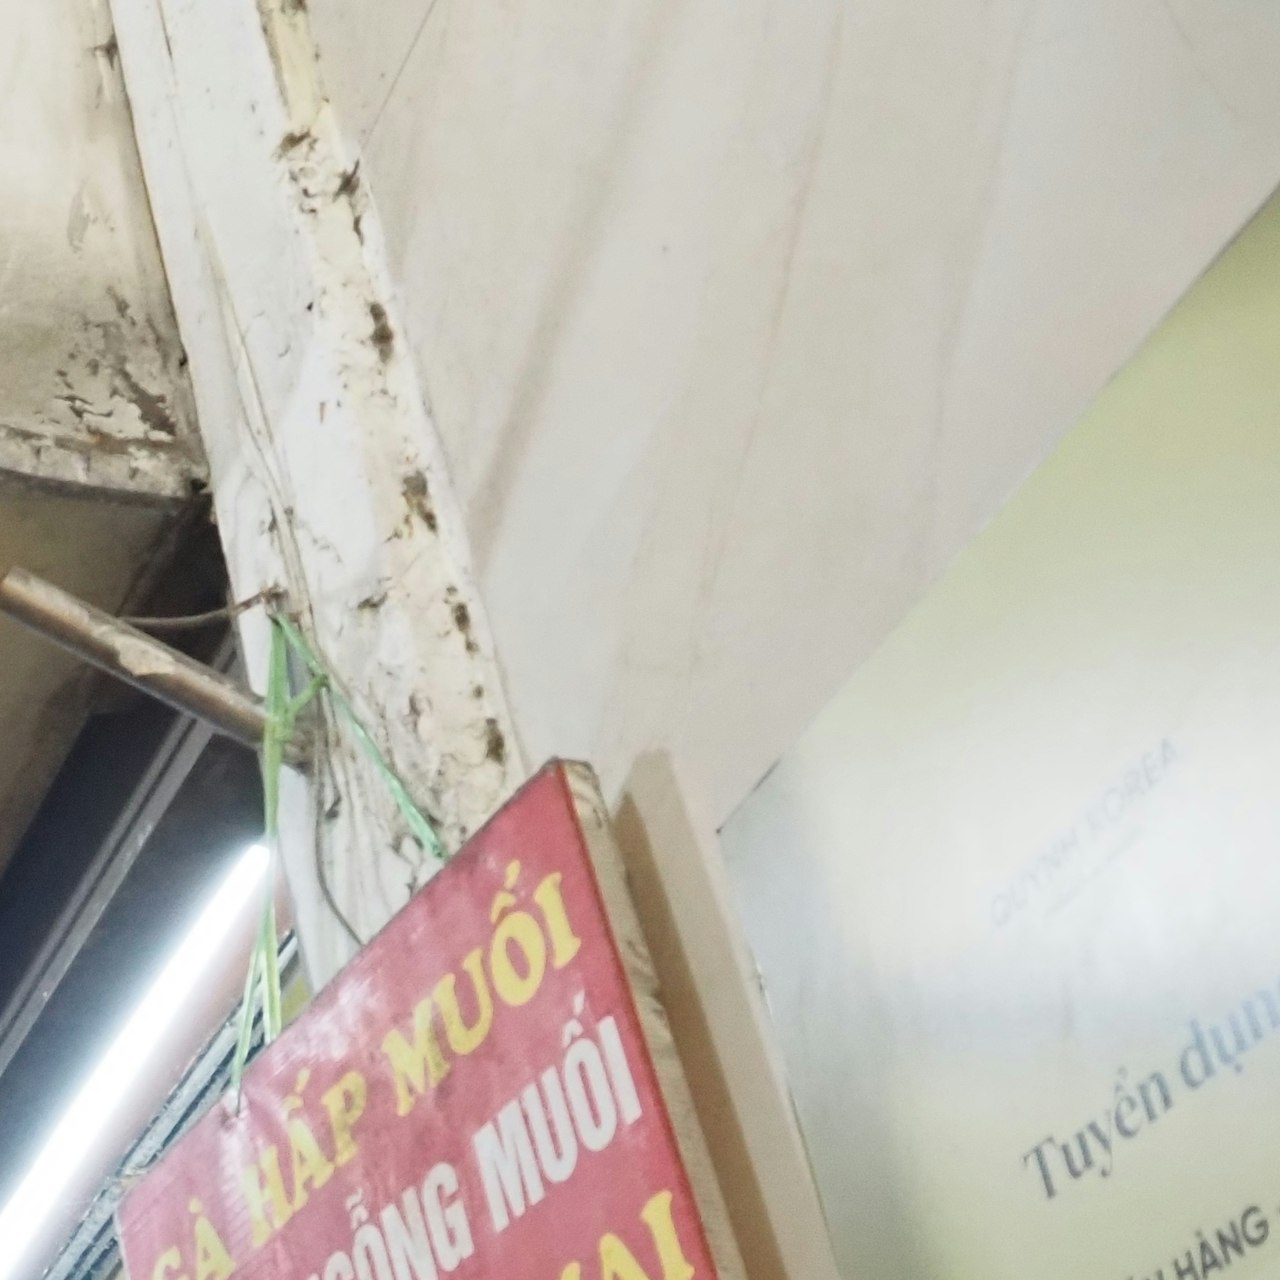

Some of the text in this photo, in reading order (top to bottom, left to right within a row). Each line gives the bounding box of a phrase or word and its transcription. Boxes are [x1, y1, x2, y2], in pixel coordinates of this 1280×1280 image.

[241, 1069, 369, 1248] HẤP
[382, 861, 582, 1117] MUỐI
[472, 991, 643, 1234] MUỐI
[1022, 975, 1280, 1200] Tuyển dụn
